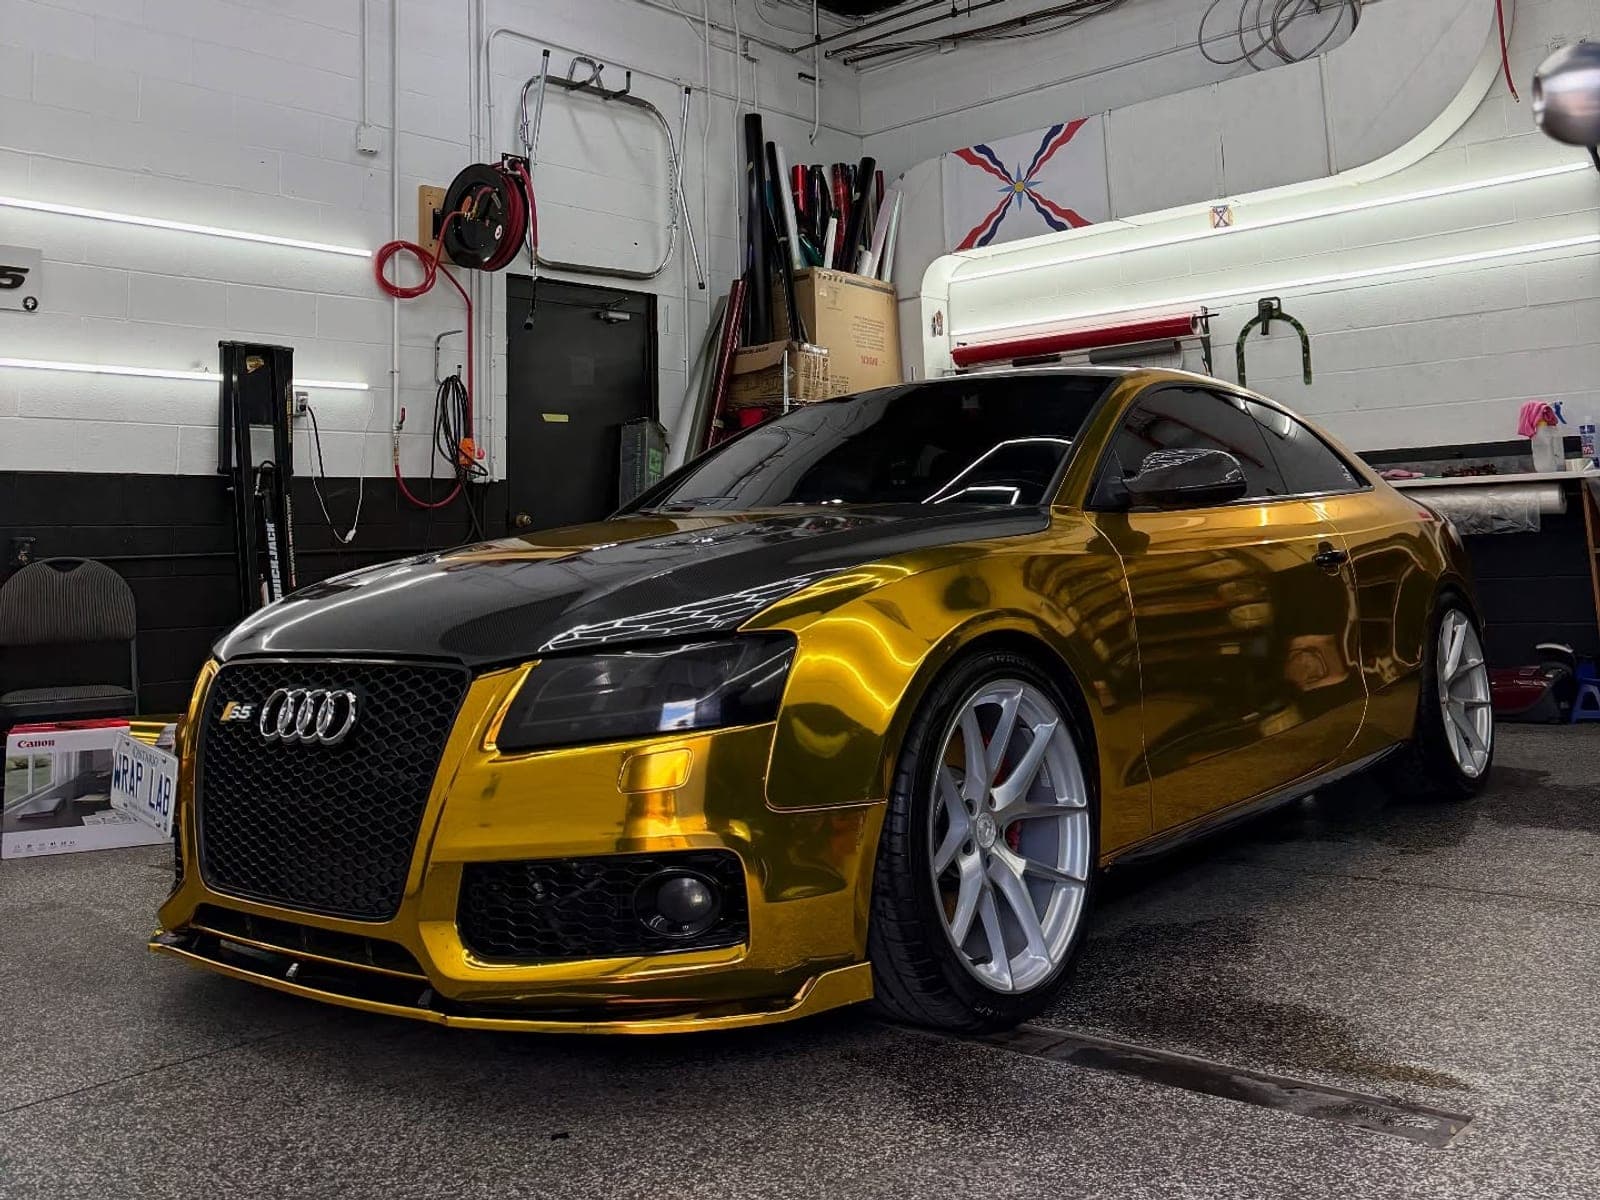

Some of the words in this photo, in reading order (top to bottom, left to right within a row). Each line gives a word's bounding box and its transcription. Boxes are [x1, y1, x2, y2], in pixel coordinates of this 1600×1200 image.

[230, 705, 252, 719] S5
[17, 740, 55, 748] Canon
[114, 751, 143, 799] WRAP
[149, 768, 171, 817] LAB
